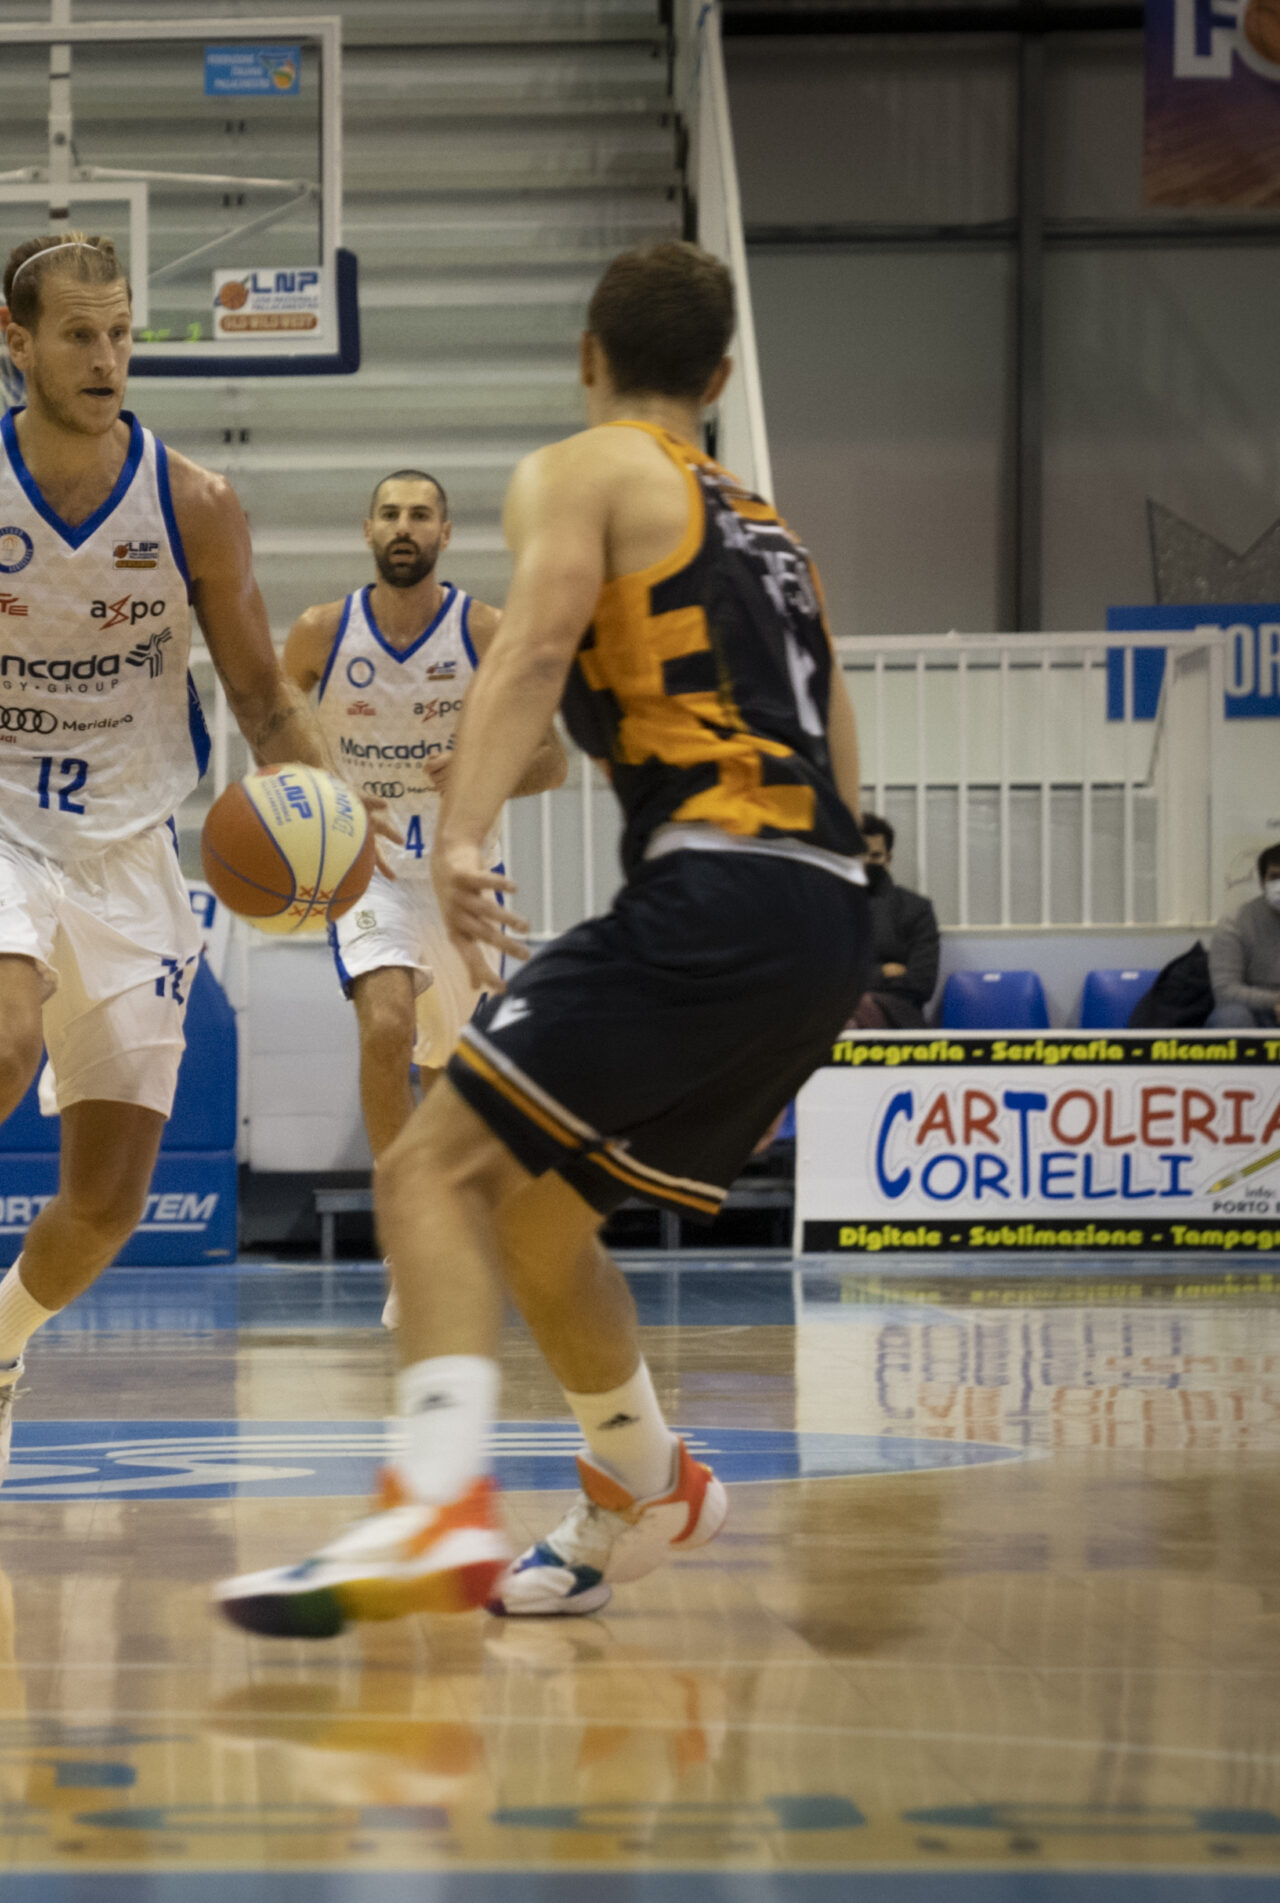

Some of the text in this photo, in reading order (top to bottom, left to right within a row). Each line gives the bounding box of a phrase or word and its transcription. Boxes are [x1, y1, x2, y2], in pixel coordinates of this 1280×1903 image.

[252, 271, 318, 293] LNP
[48, 678, 120, 694] GROUP
[32, 756, 89, 815] 12
[277, 774, 314, 819] LNP
[406, 814, 425, 859] 4
[832, 1040, 965, 1065] Tipografia
[991, 1039, 1125, 1064] Serigrafia
[1151, 1038, 1238, 1061] Ricami
[876, 1136, 1194, 1200] CORTELLI
[1212, 1201, 1270, 1214] PORTO
[838, 1226, 942, 1250] Digitale
[968, 1225, 1143, 1246] Sublimazione
